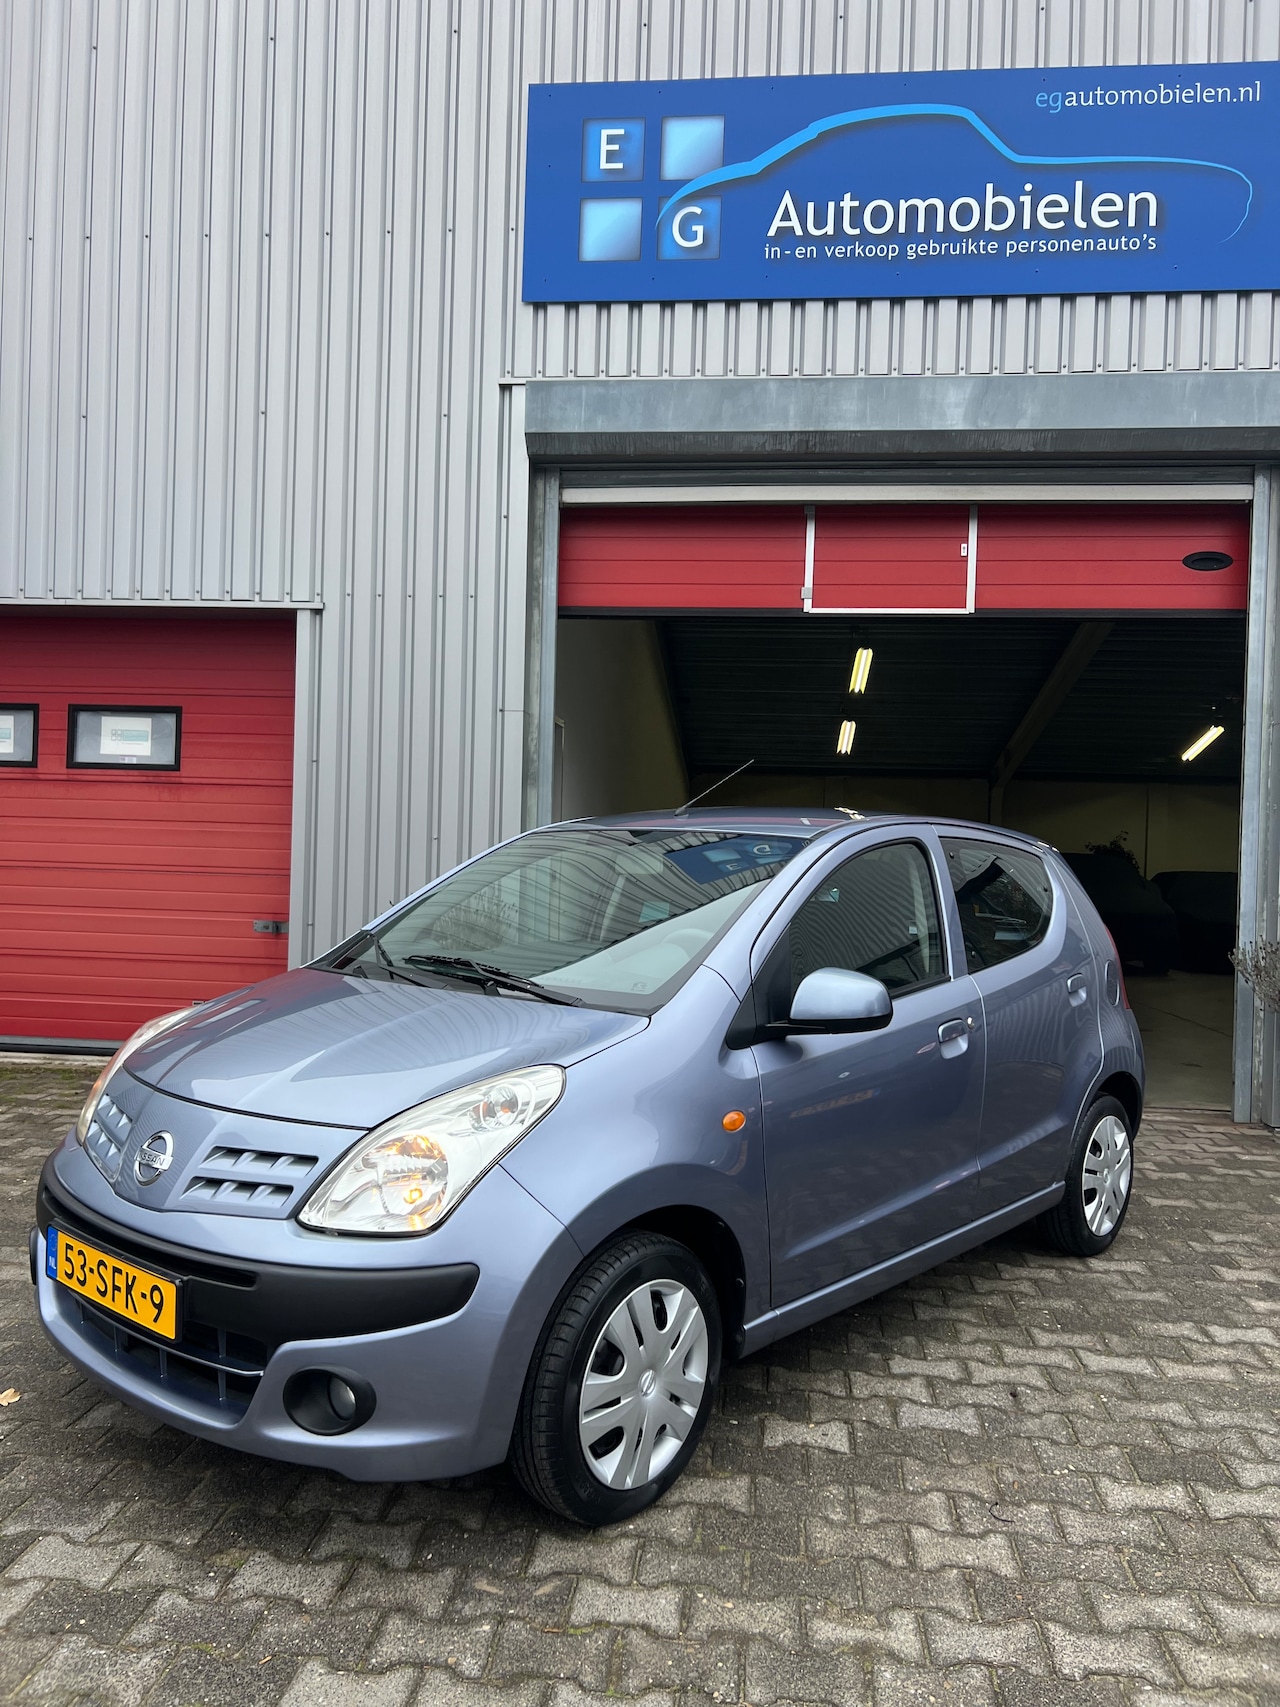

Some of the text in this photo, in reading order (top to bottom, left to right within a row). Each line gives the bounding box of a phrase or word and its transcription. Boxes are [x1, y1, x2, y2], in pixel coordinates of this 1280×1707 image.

[1035, 80, 1261, 113] egautomobielen.nl
[599, 128, 625, 170] E
[672, 205, 704, 248] G
[766, 180, 1157, 237] Automobielen
[824, 240, 899, 260] verkoop
[906, 238, 999, 260] gebruikte
[64, 1242, 164, 1324] 53-SFK-9
